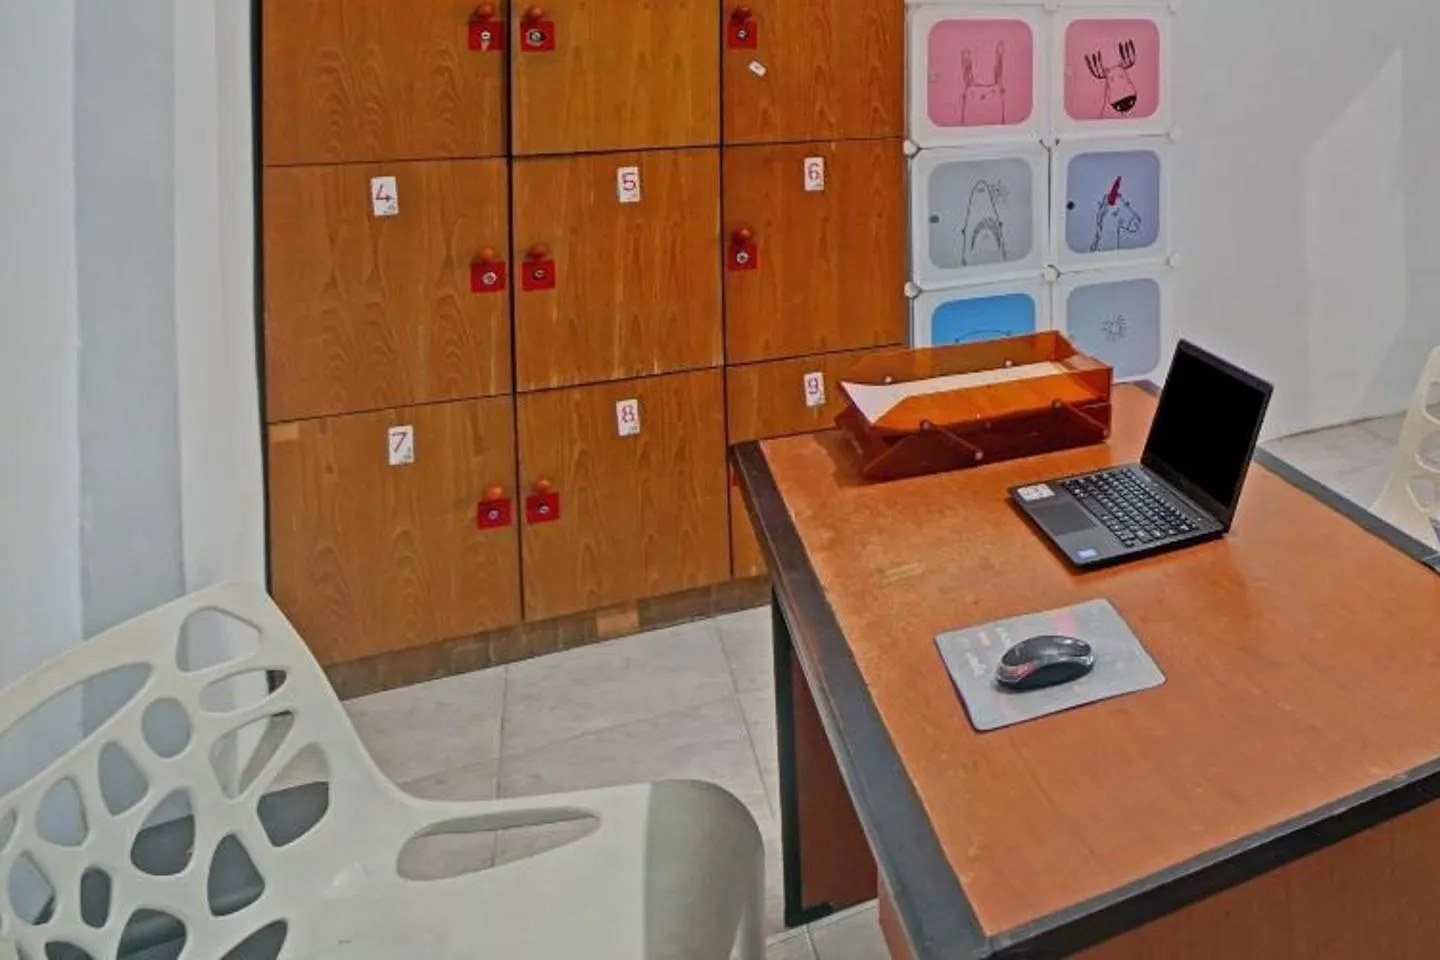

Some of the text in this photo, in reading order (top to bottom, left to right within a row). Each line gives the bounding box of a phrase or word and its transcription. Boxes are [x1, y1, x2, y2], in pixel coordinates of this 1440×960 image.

[808, 162, 820, 181] 6
[622, 172, 636, 191] 5
[376, 184, 392, 202] 4
[808, 376, 819, 395] 9
[621, 404, 635, 423] 8
[391, 431, 408, 453] 7
